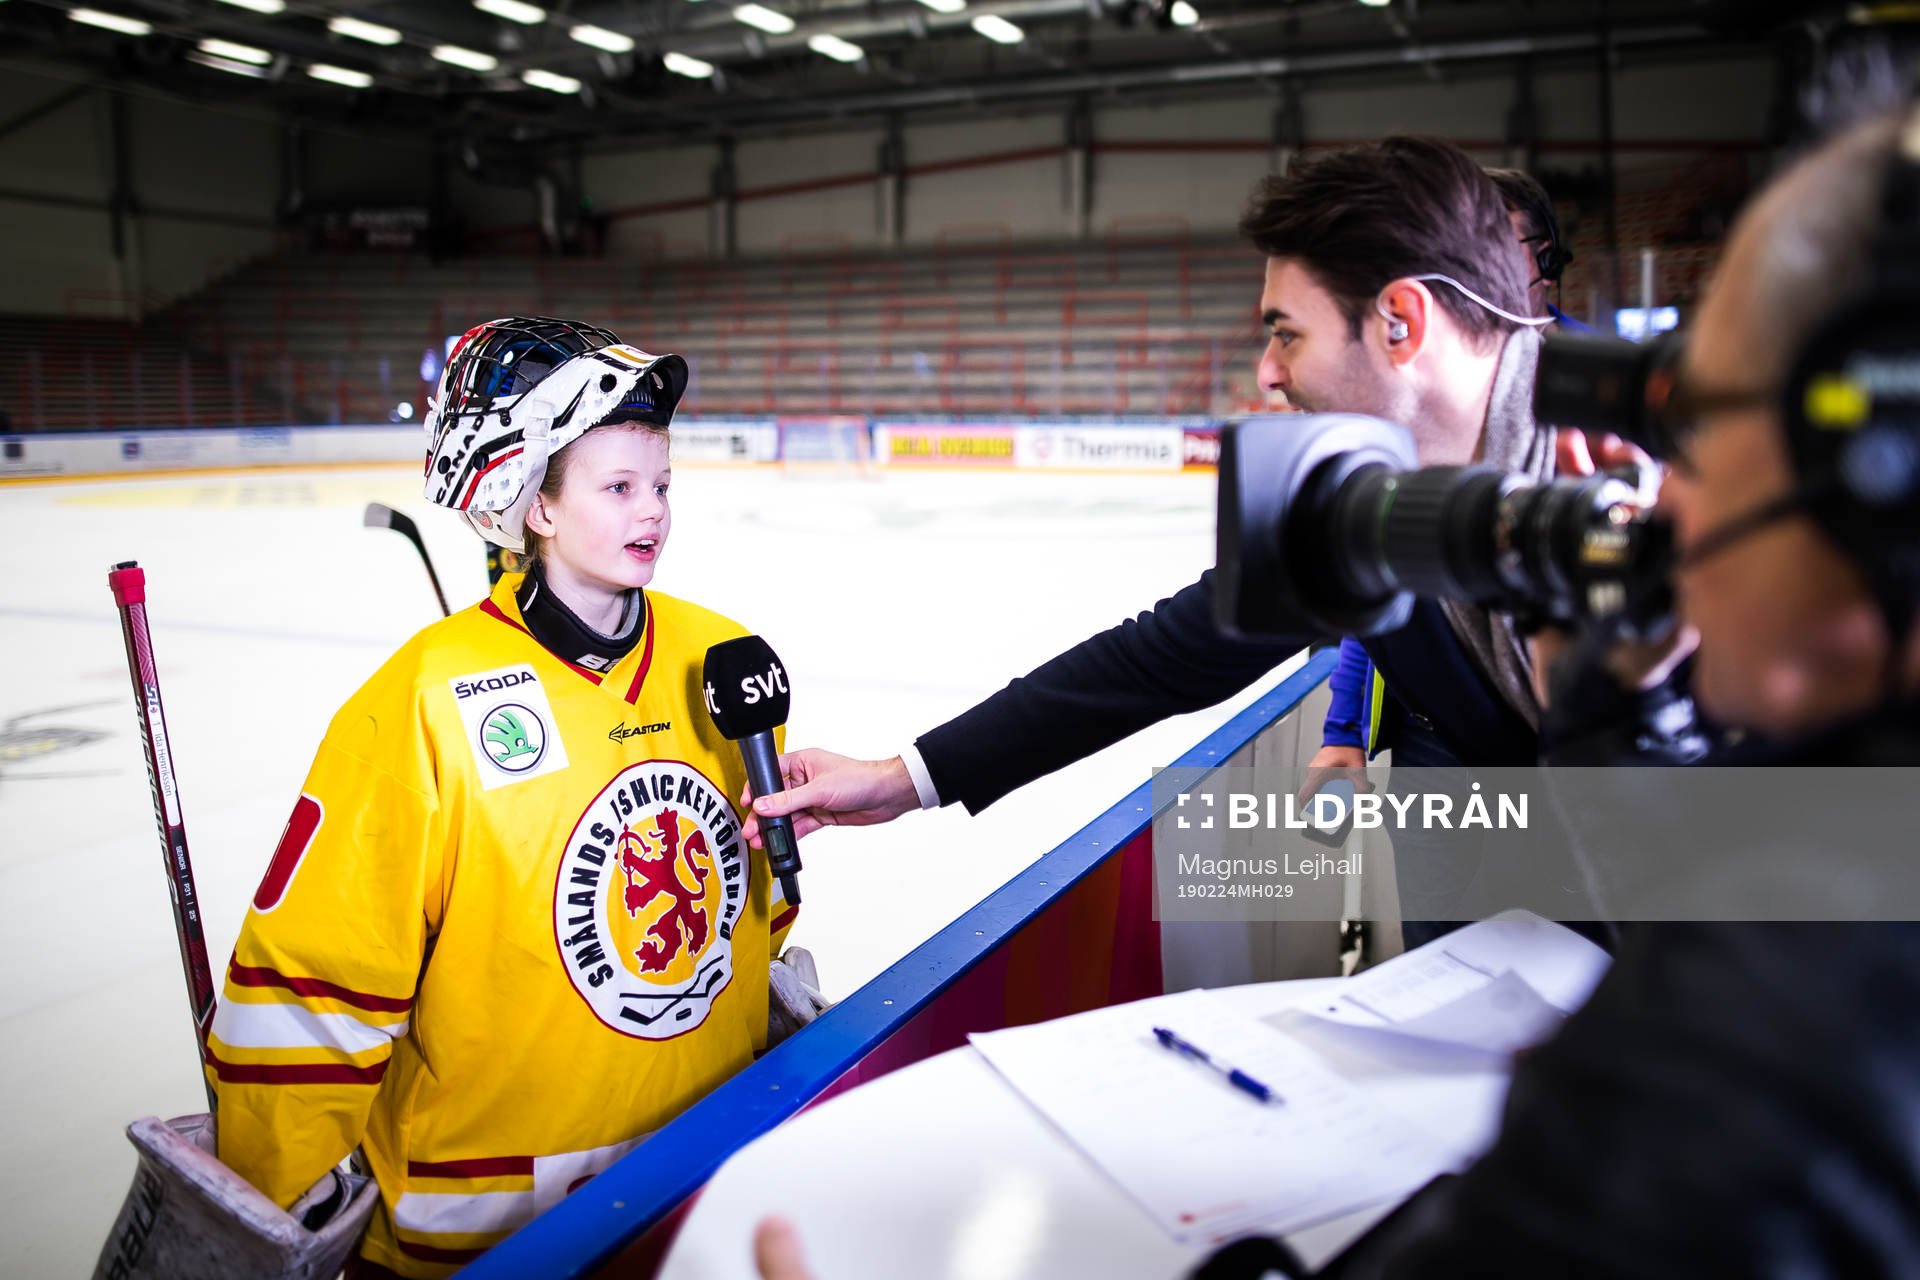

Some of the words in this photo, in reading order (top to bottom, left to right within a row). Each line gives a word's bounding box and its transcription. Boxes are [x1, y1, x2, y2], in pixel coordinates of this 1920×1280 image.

[455, 671, 537, 699] ŠKODA
[741, 663, 788, 704] svt
[155, 733, 164, 748] Ida
[622, 722, 671, 738] EASTON
[157, 748, 172, 797] Henriksson
[176, 845, 186, 871] SENIOR
[563, 821, 616, 989] SMÅLANDS
